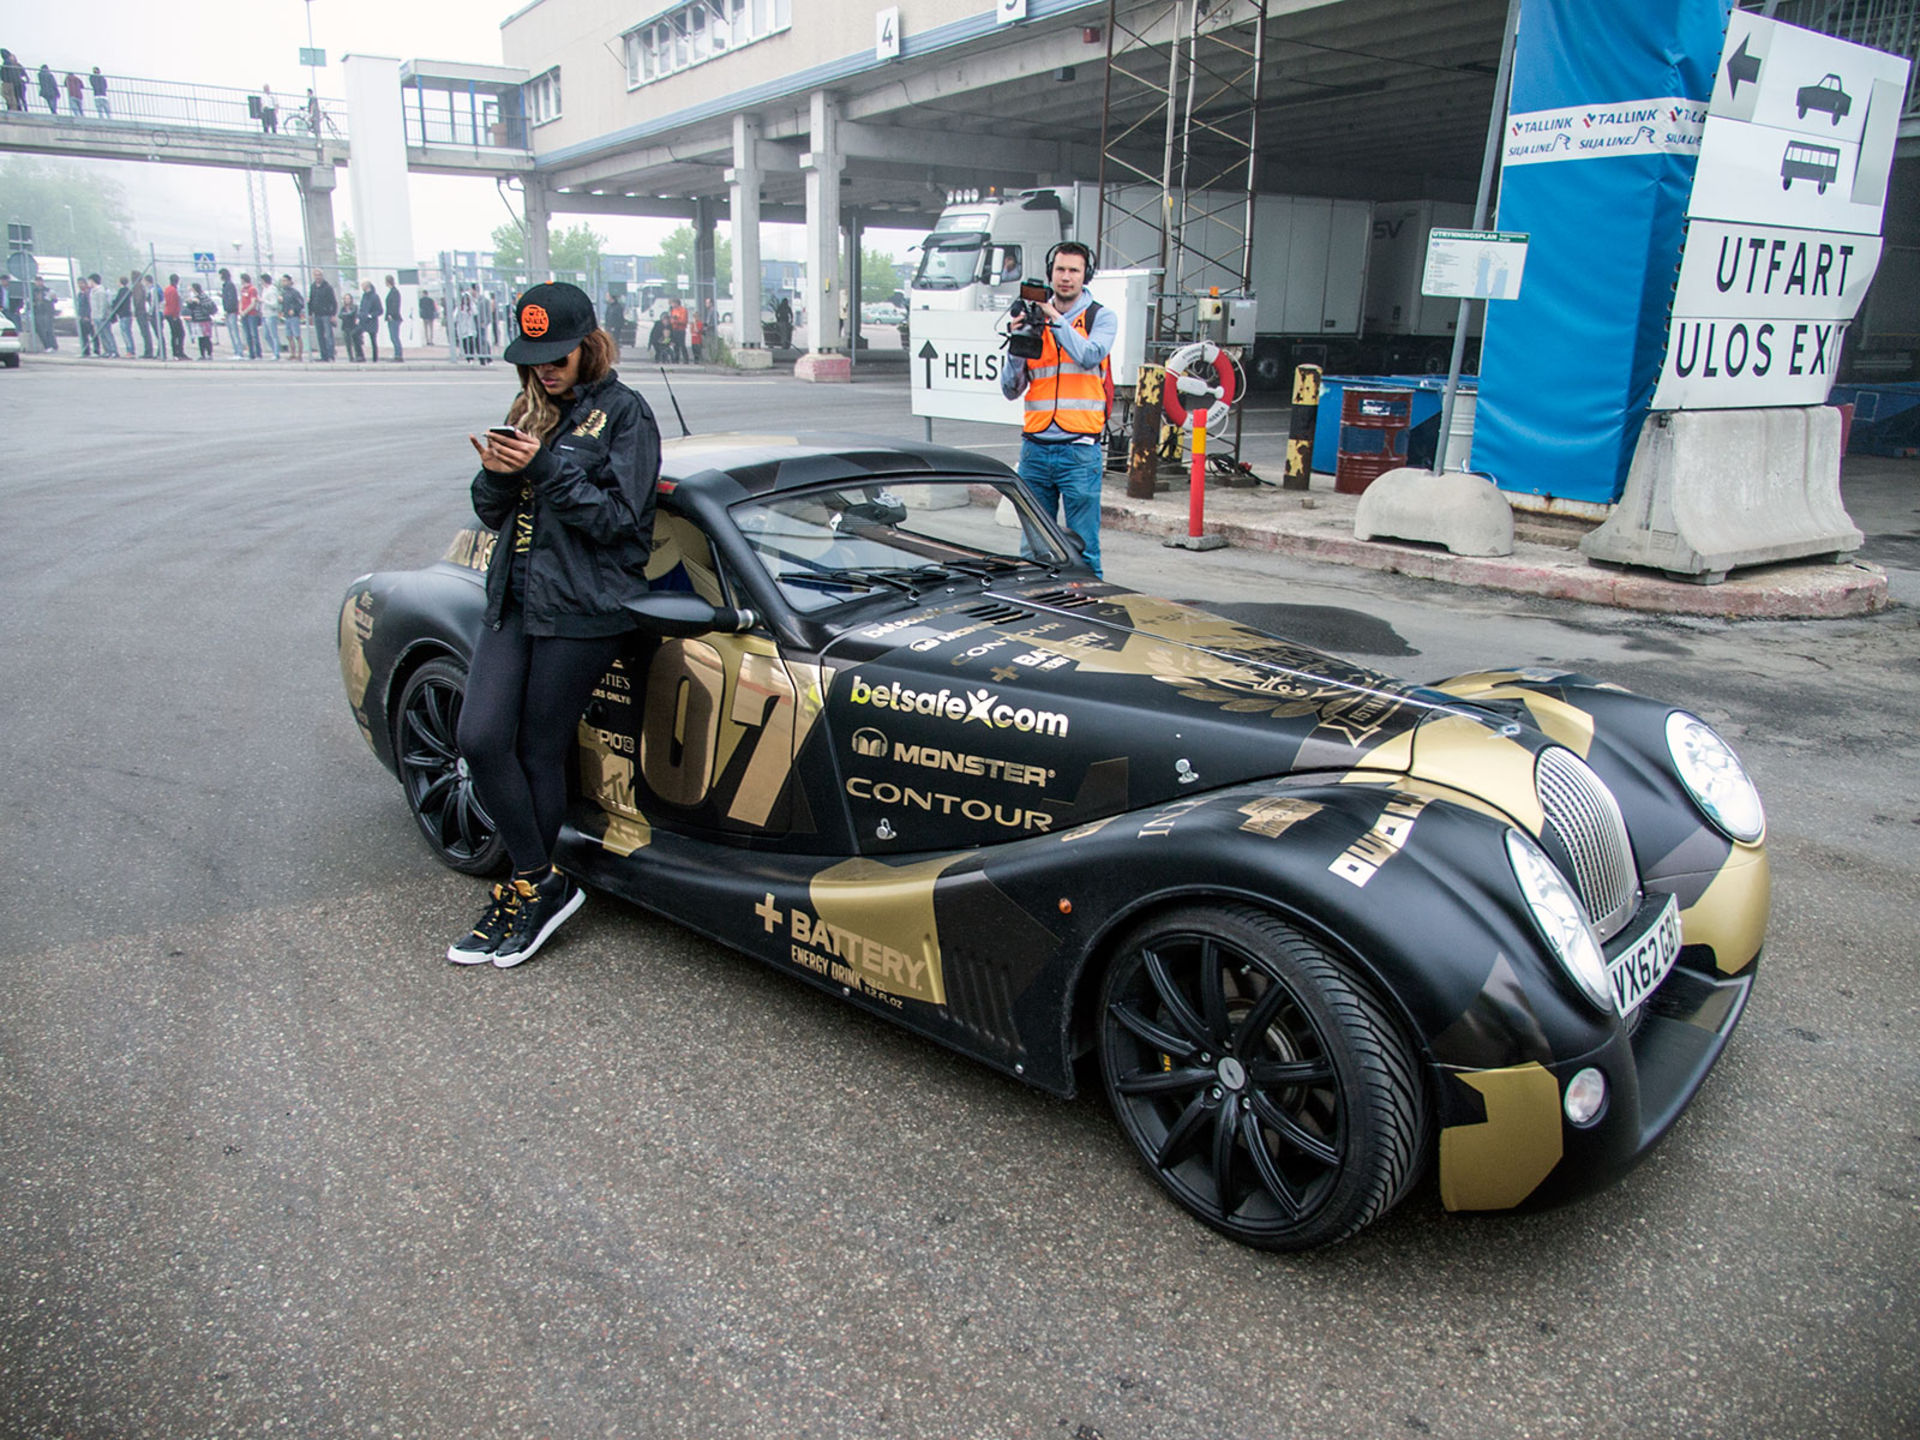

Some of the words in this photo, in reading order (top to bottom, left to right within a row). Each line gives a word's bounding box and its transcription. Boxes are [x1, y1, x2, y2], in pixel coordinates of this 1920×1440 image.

[882, 17, 893, 48] 4
[1524, 116, 1573, 134] TALLINK
[1601, 109, 1658, 125] TALLINK
[1508, 145, 1529, 157] SILJA
[1530, 143, 1552, 154] LINE
[1578, 138, 1605, 149] SILJA
[1606, 135, 1634, 147] LINE
[1716, 235, 1855, 297] UTFART
[1675, 322, 1776, 378] ULOS
[641, 638, 797, 828] 07
[846, 777, 1053, 832] CONTOUR
[791, 944, 829, 976] ENERGY
[831, 961, 862, 991] DRINK
[1612, 937, 1661, 1009] VX62
